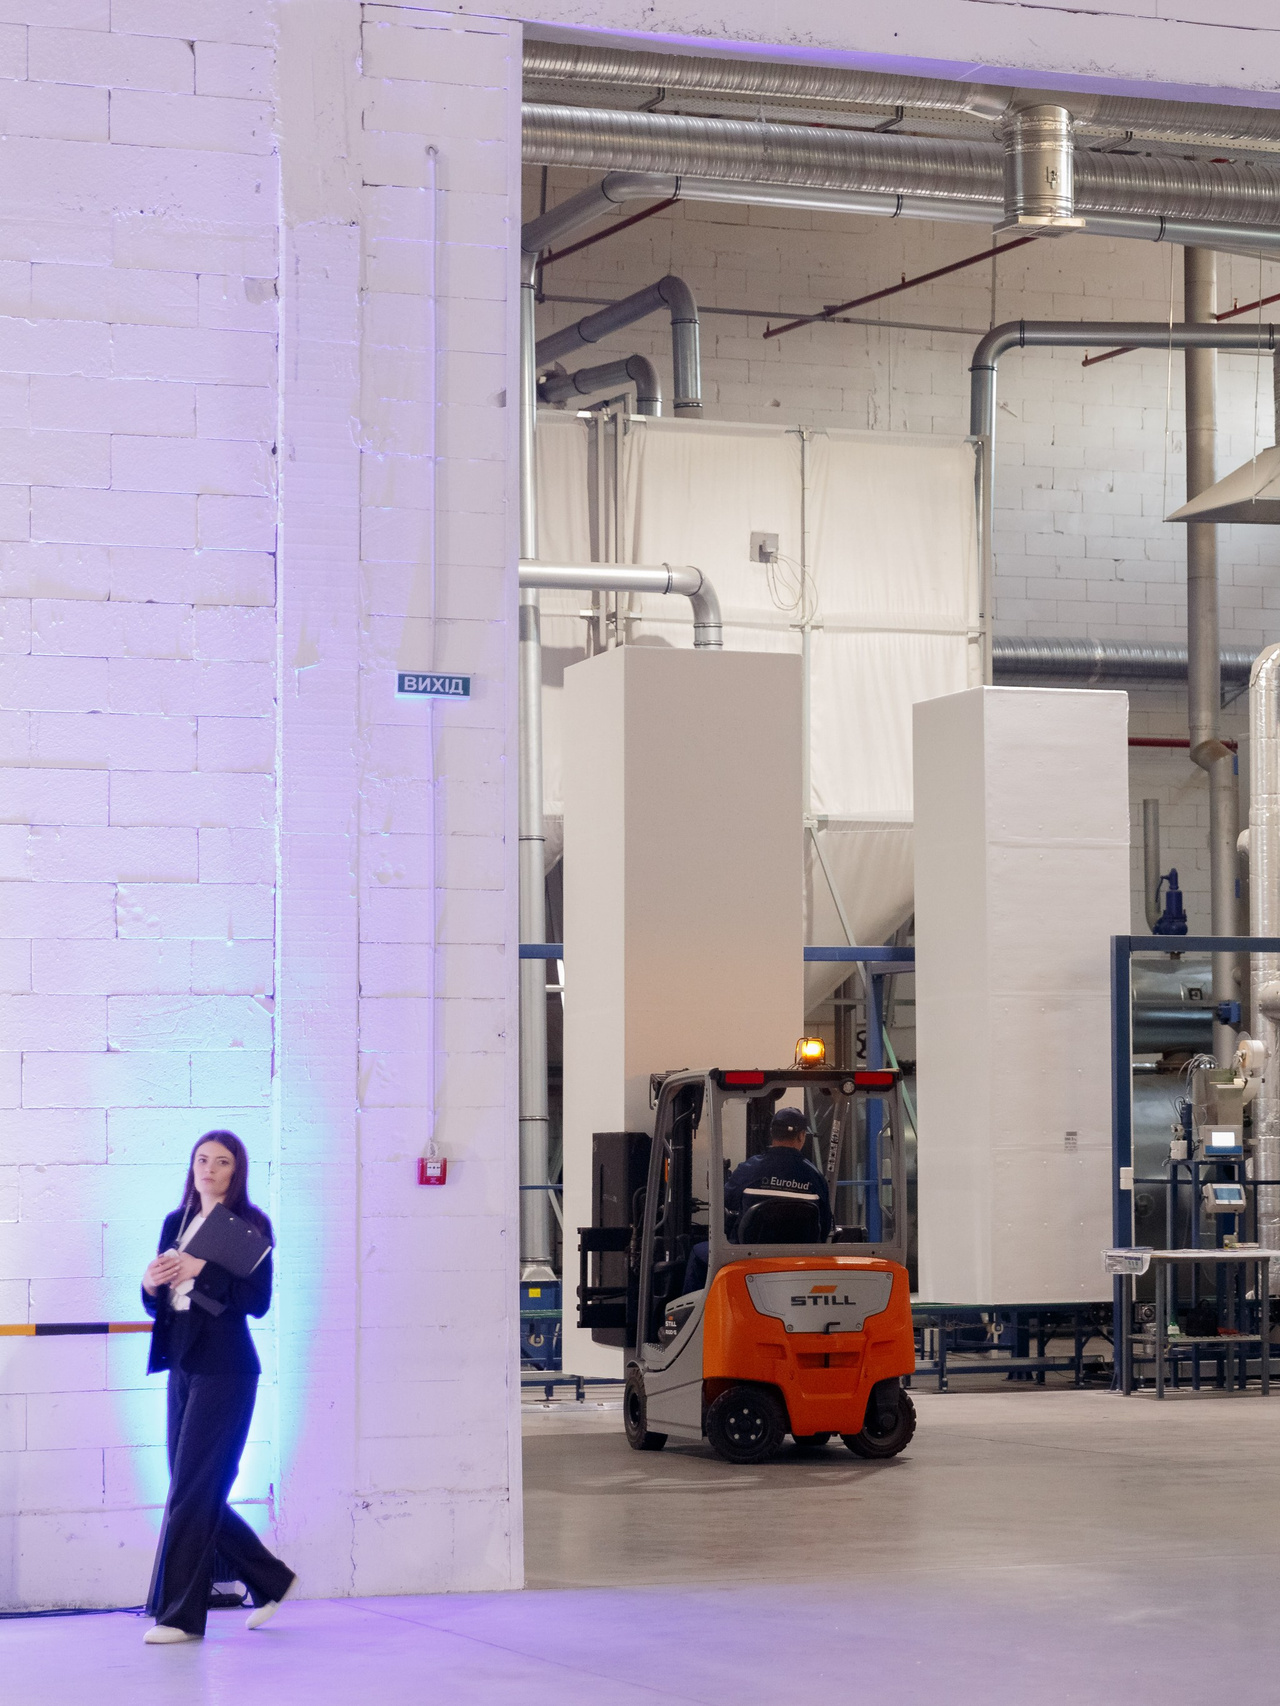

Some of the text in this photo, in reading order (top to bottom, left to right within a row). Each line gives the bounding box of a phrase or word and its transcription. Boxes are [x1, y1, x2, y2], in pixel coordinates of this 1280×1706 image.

[404, 676, 464, 695] ВИХІД
[770, 1176, 810, 1190] Eurobud
[791, 1295, 856, 1306] STILL
